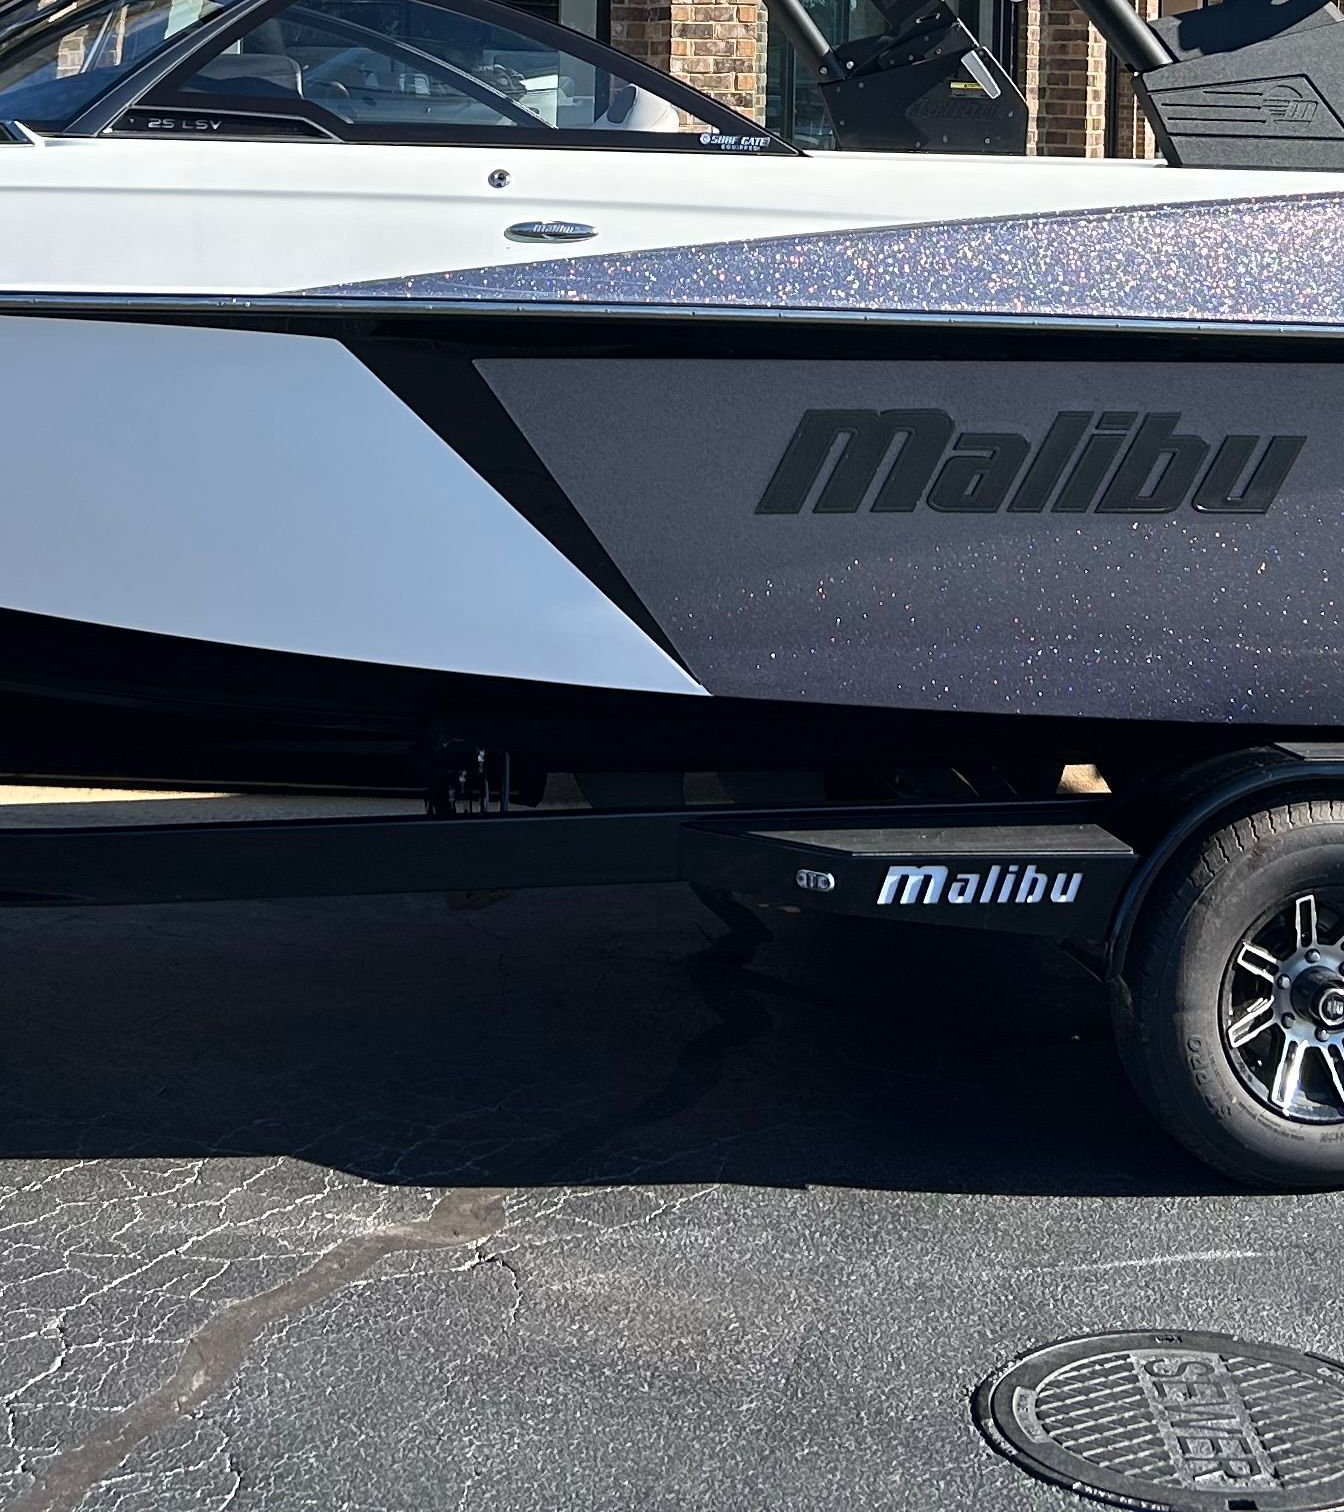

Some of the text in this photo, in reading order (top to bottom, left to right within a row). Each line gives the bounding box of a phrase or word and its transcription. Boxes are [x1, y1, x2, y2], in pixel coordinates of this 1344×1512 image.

[148, 118, 222, 130] 25 LSV
[711, 135, 768, 147] SURF GATE
[755, 408, 1308, 515] Malibu
[877, 864, 1084, 905] Malibu
[1187, 1036, 1213, 1086] PRO
[1143, 1358, 1262, 1482] SEWER
